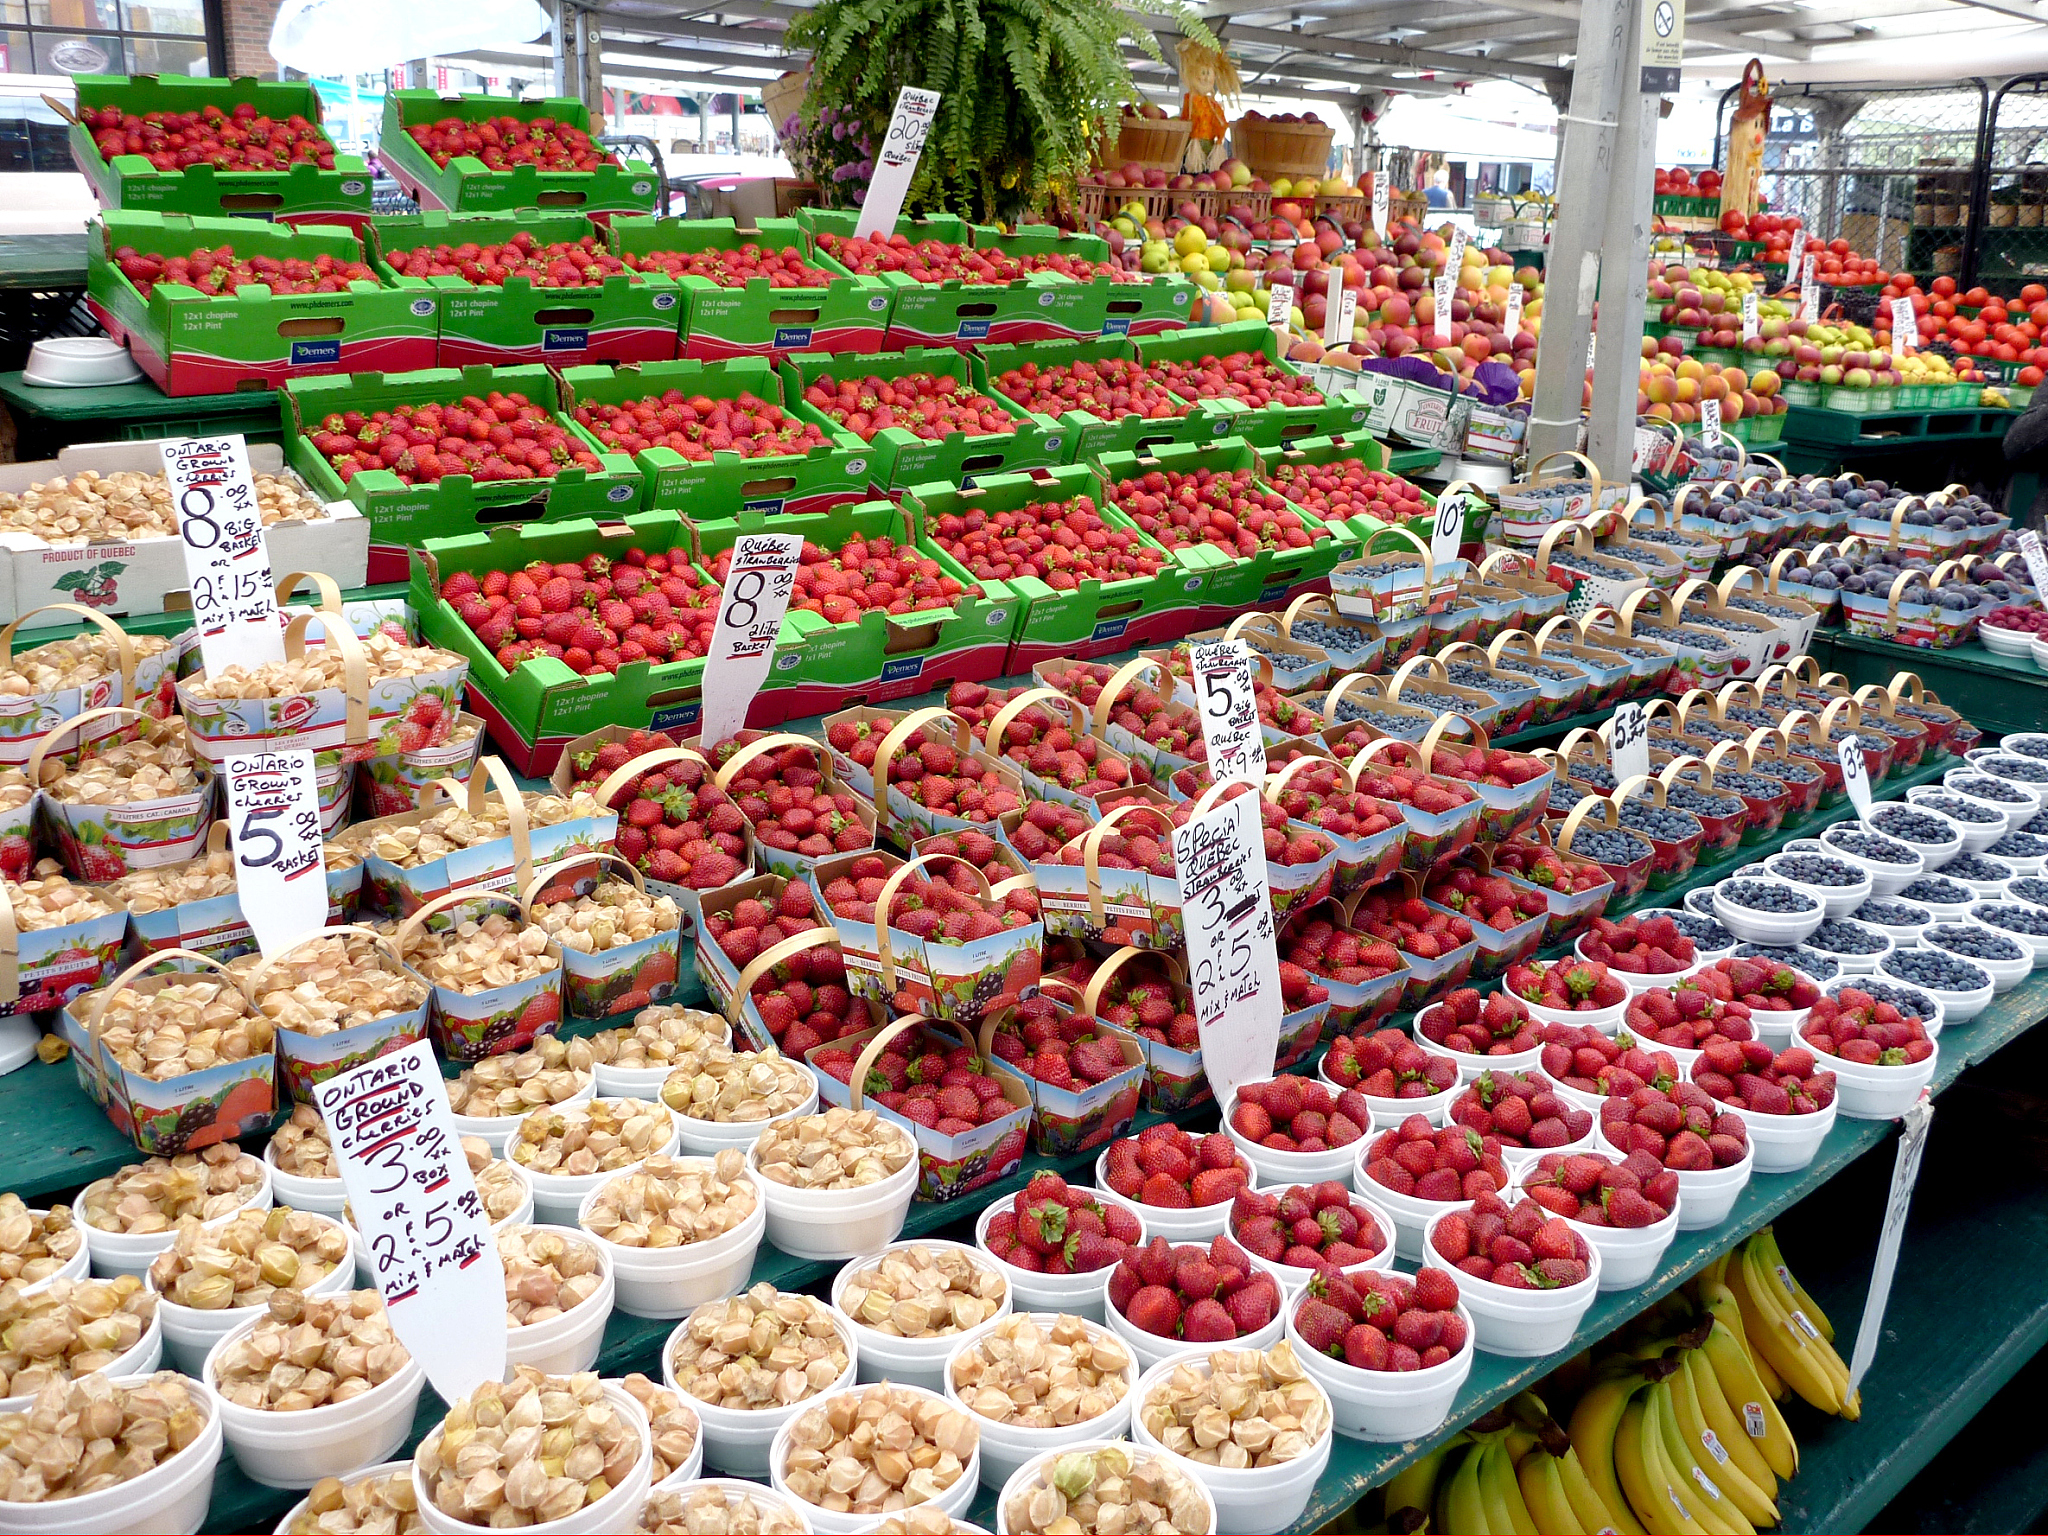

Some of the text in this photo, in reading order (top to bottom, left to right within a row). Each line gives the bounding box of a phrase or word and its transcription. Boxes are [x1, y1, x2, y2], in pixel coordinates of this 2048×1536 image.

[545, 291, 602, 300] www.phdemers.com
[290, 299, 354, 311] www.phdemers.com
[450, 300, 498, 309] 12x1 chopine
[716, 299, 741, 308] chopine
[183, 311, 239, 321] 12x1 chopine
[450, 309, 484, 317] 12x1 Pint
[700, 308, 728, 316] 12x1 Pint
[183, 321, 222, 330] 12x1 Pint
[550, 333, 584, 343] Demers
[780, 331, 808, 341] Demers
[299, 346, 336, 357] Demers
[1414, 417, 1443, 432] FRUIT
[165, 440, 231, 458] OnTARiO
[176, 456, 235, 470] GROUND
[662, 476, 706, 487] 12x1 chopine
[661, 486, 692, 496] 12x1 Pint
[374, 503, 430, 514] 12x1 chopine
[374, 513, 412, 523] 12x1 Pint
[224, 518, 255, 536] BiG
[219, 528, 262, 552] BASKET
[740, 538, 791, 553] Québec
[42, 546, 136, 563] PRODUCT OF QUEBEC
[210, 559, 230, 567] OR
[194, 576, 221, 610] 2
[202, 613, 224, 625] MiX
[239, 600, 275, 617] MATch
[820, 639, 846, 651] chopine
[818, 651, 832, 660] Pint
[1195, 645, 1239, 660] Québec
[888, 662, 918, 676] Demers
[556, 691, 609, 706] 12x1 chopine
[553, 703, 591, 716] 12x1 Pint
[658, 709, 695, 722] Demers
[1211, 732, 1250, 746] Québec
[231, 753, 304, 773] OnTARiO
[234, 777, 302, 791] GROUND
[235, 793, 302, 806] cheRRies
[164, 807, 191, 816] CANADA
[272, 843, 321, 872] BASKET
[482, 876, 513, 889] BERRIES
[1126, 908, 1146, 916] FRUITS
[216, 930, 251, 941] BERRIES
[1210, 930, 1225, 948] OR
[24, 960, 91, 978] PETITS FRUITS
[860, 959, 880, 969] BERRIES
[1195, 959, 1216, 995] 2
[1200, 998, 1221, 1021] MiX
[1231, 971, 1260, 1000] MATch
[323, 1056, 421, 1108] OnTARiO
[336, 1082, 424, 1131] GROUND
[342, 1099, 435, 1149] cheRRies
[413, 1163, 449, 1184] BOX
[383, 1202, 410, 1221] OR
[372, 1234, 405, 1272] 2
[385, 1271, 419, 1294] MiX
[439, 1235, 486, 1267] MATch
